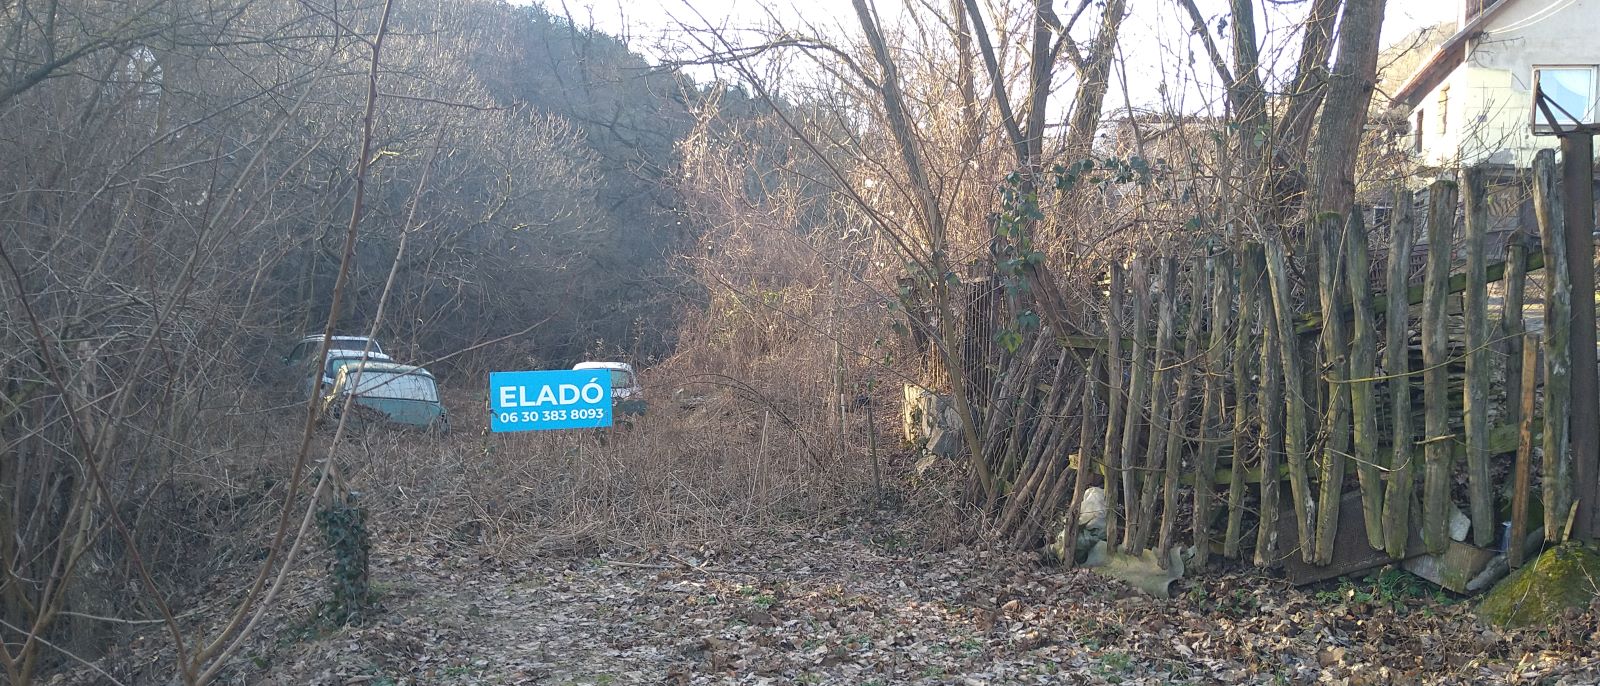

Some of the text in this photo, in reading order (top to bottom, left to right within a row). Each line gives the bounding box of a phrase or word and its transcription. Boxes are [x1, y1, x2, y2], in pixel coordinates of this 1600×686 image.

[500, 377, 604, 407] ELADÓ
[500, 408, 605, 422] 06 30 383 8093
